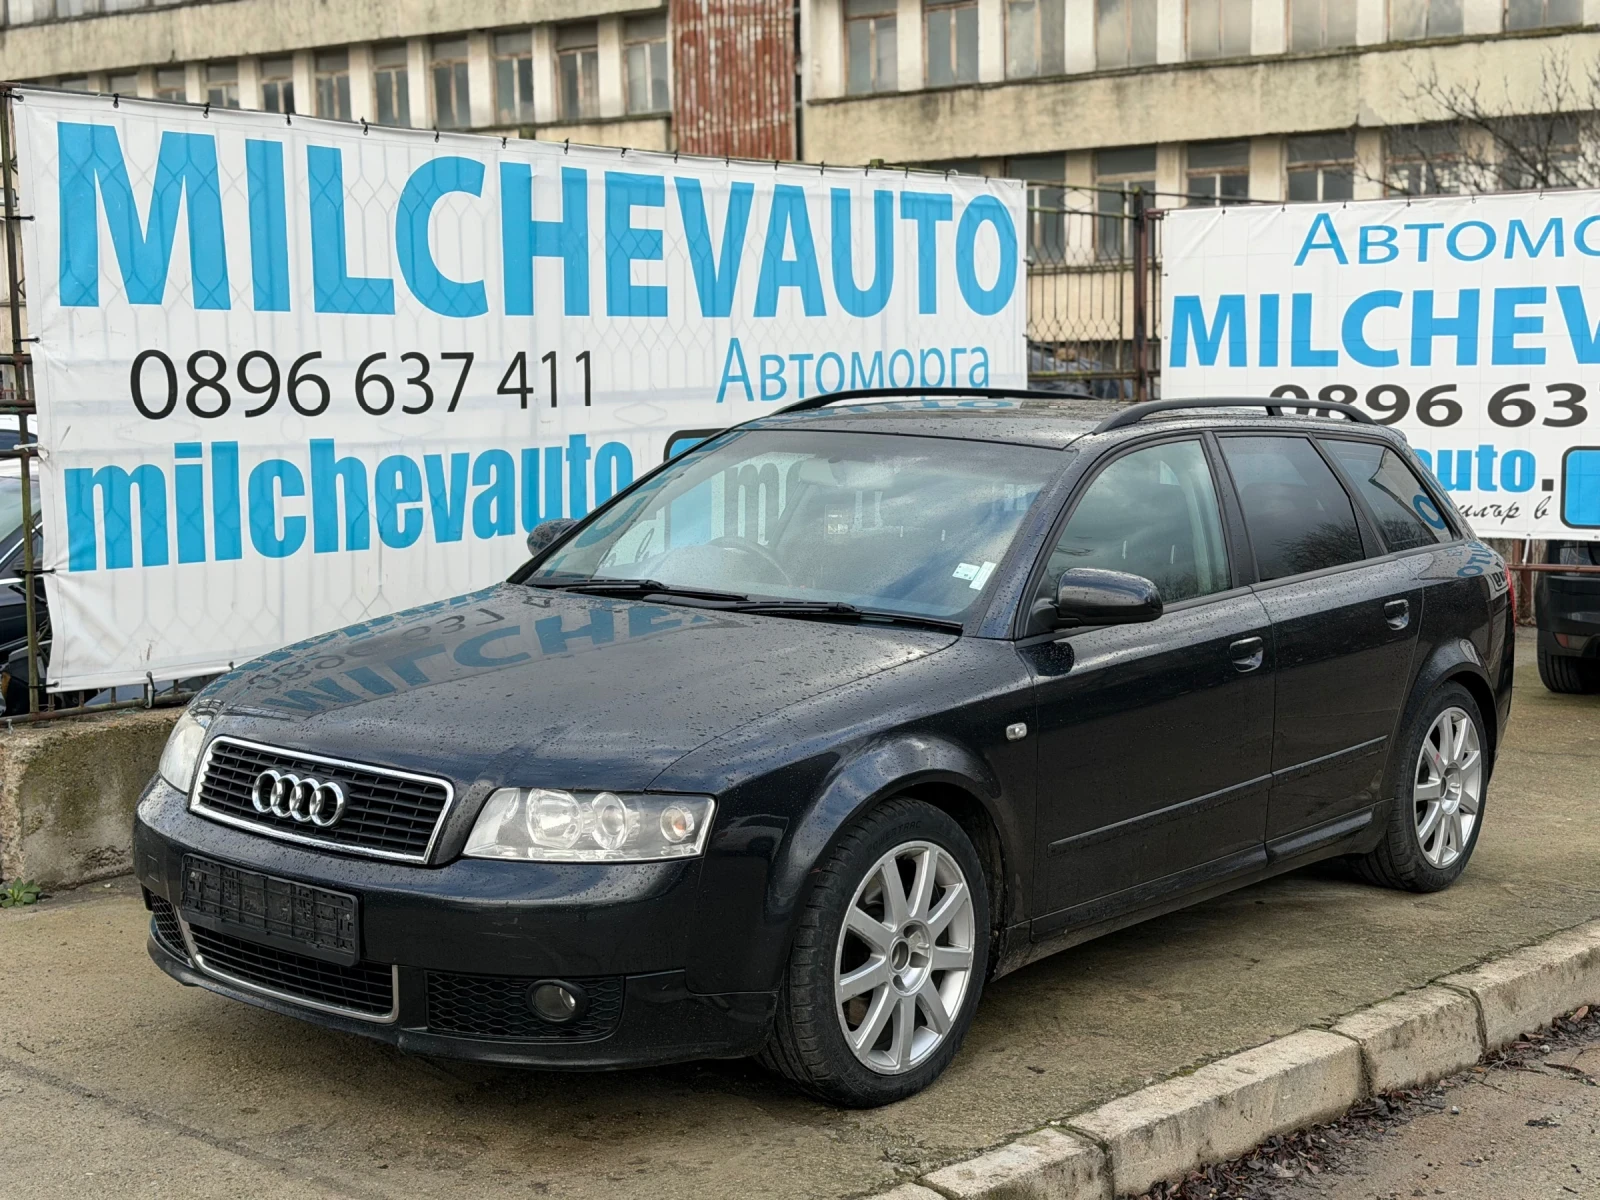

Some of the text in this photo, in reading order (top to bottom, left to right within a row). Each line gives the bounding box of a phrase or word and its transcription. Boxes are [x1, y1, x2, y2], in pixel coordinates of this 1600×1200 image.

[57, 121, 1018, 318] MILCHEVAUTO
[130, 349, 591, 420] 0896 637 411
[717, 337, 990, 404] Автоморга
[1487, 382, 1600, 428] 63
